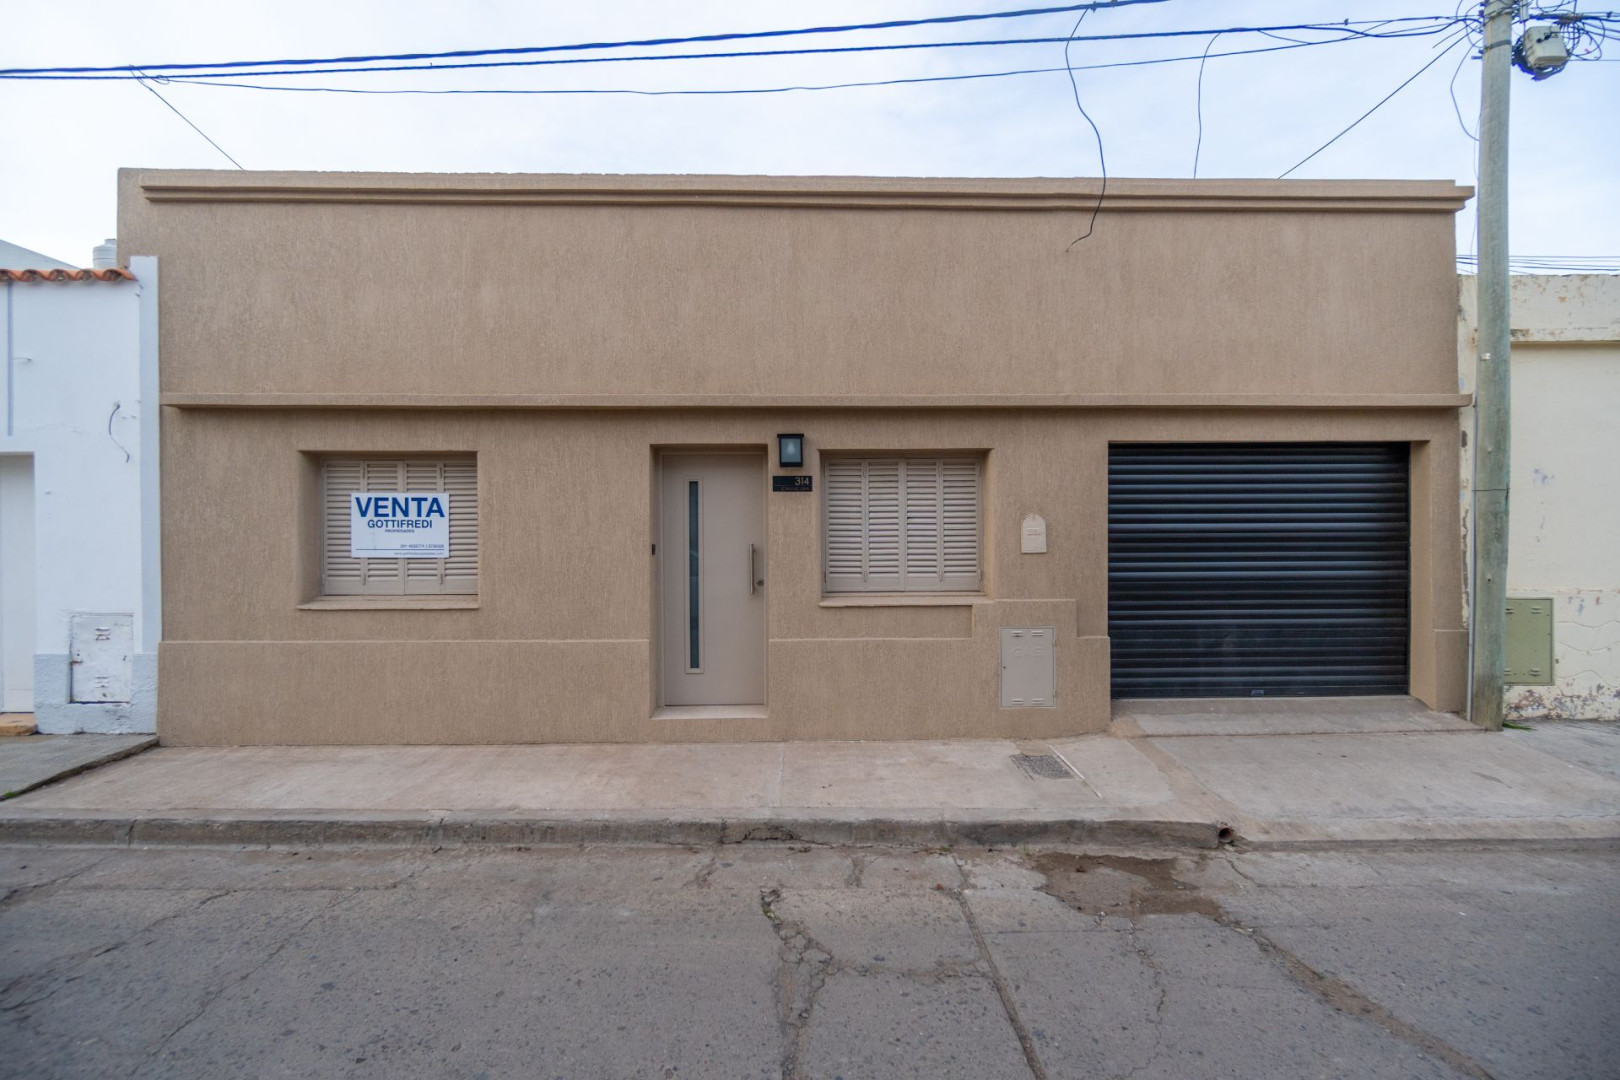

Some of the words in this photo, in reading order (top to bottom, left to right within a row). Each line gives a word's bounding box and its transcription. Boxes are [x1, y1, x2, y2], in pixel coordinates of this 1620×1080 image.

[794, 476, 810, 485] 314
[355, 497, 445, 517] VENTA
[367, 519, 432, 528] GOTTIFREDI
